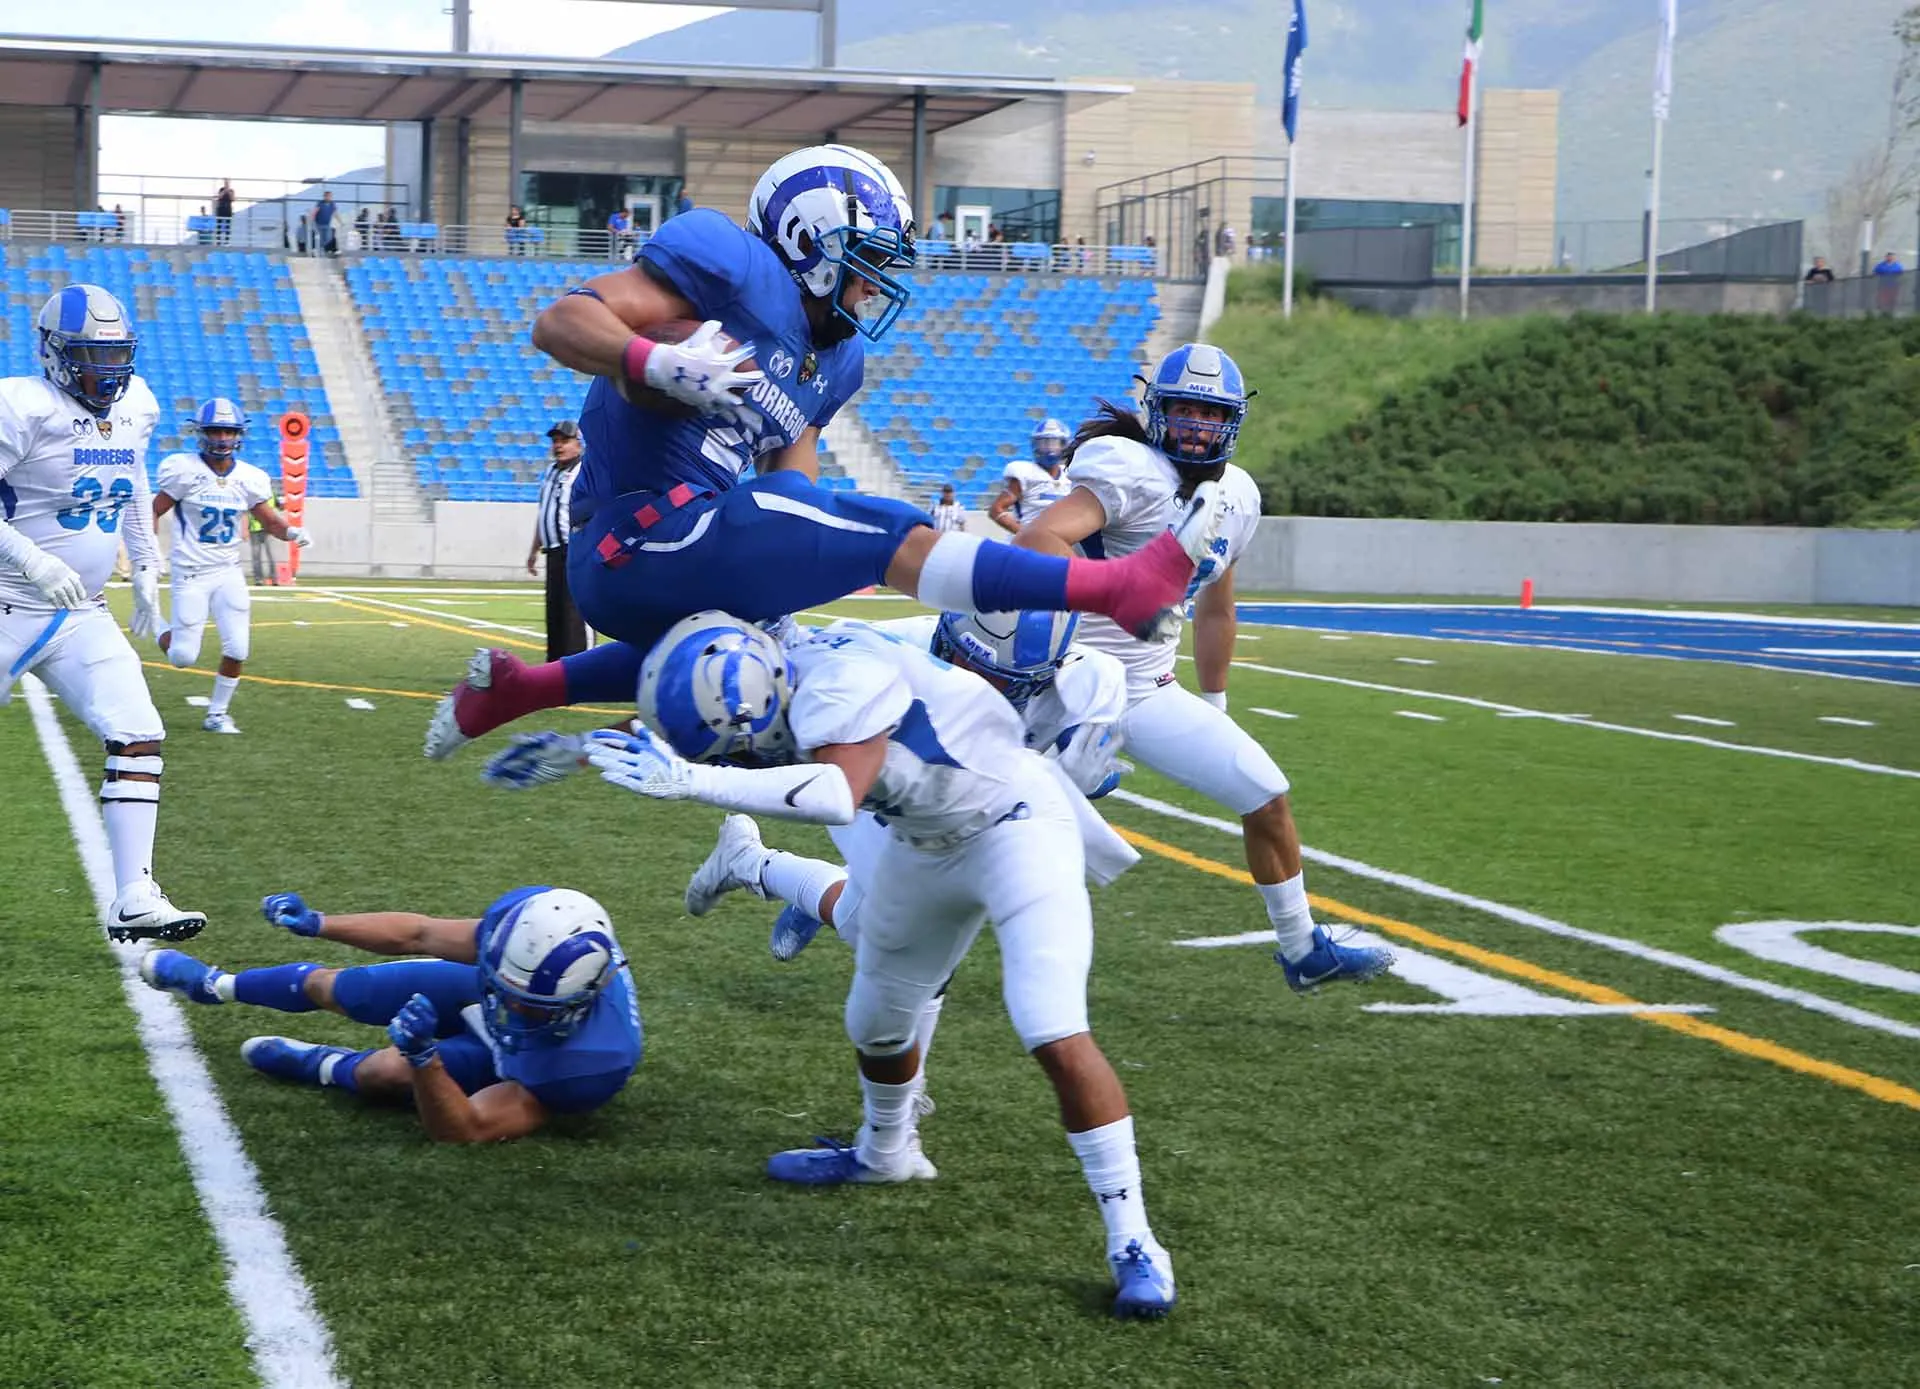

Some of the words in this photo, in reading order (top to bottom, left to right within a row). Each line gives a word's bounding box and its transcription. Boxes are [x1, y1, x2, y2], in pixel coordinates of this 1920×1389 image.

[1188, 383, 1217, 393] MEX
[743, 378, 809, 445] ORREGO
[73, 447, 136, 466] BORREGOS
[198, 506, 237, 543] 25
[964, 636, 992, 660] MEX
